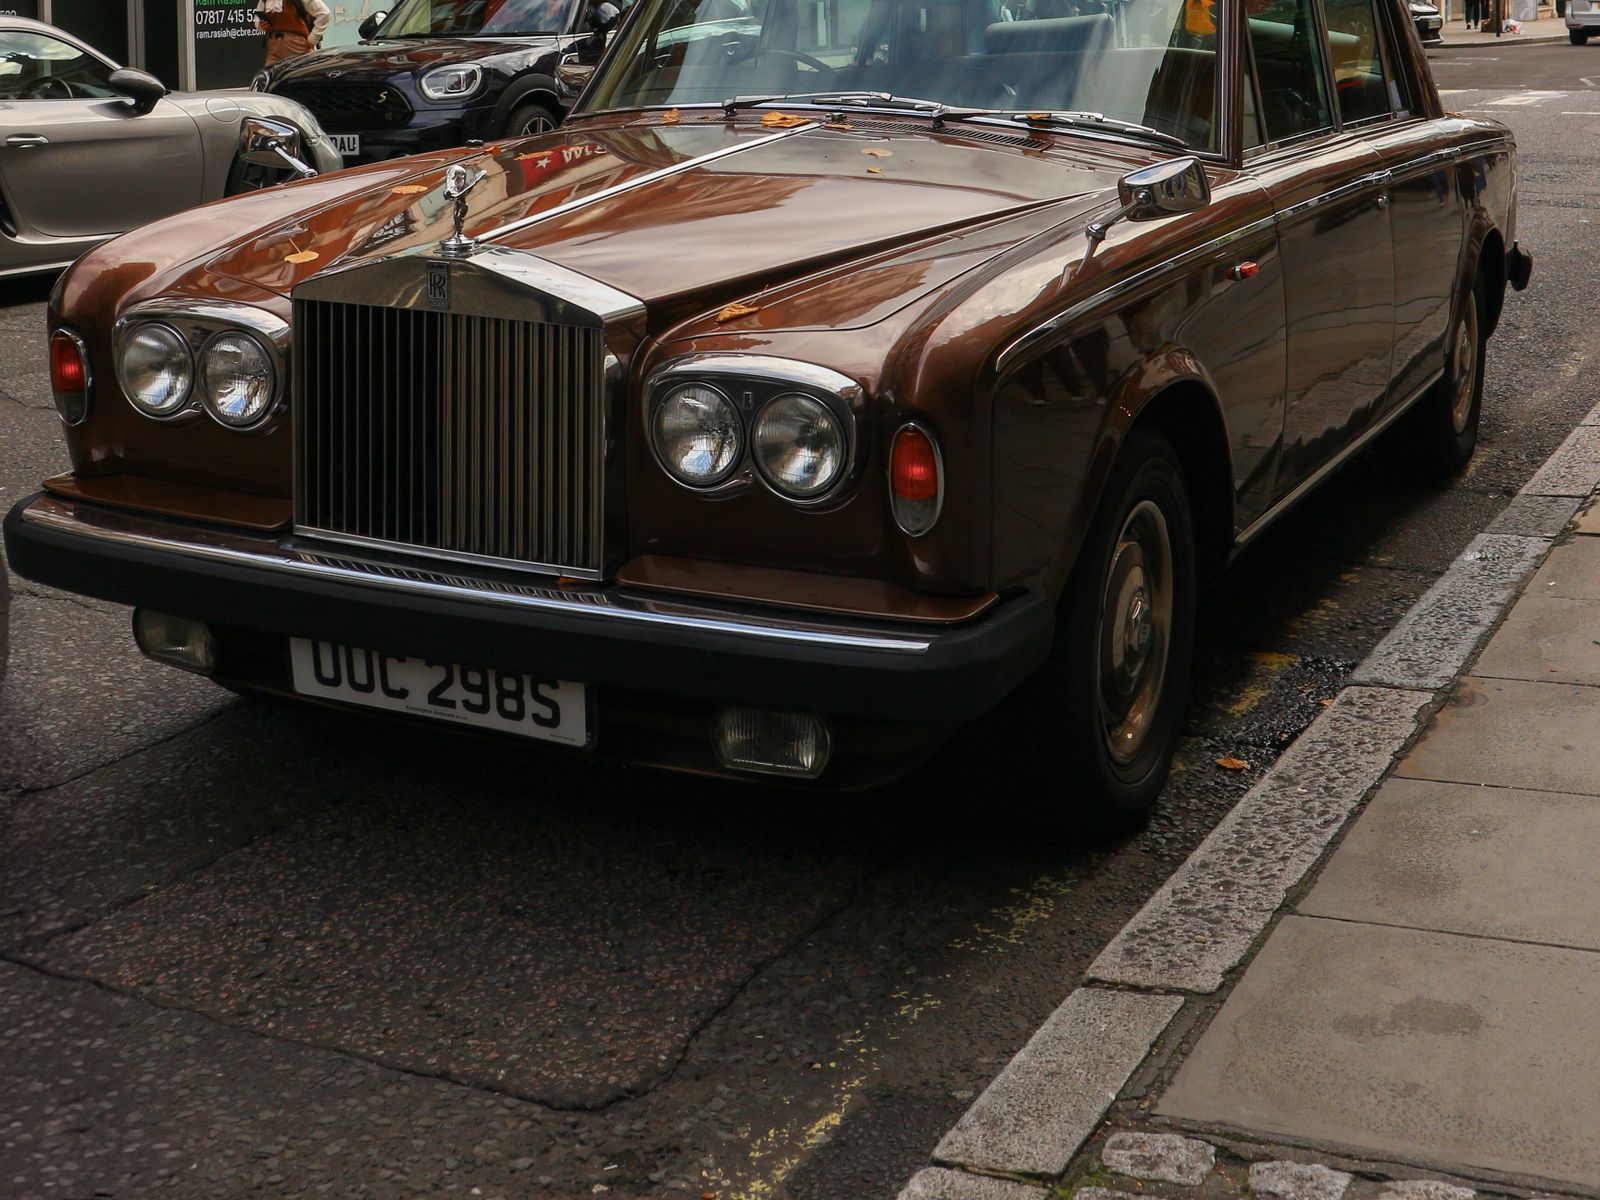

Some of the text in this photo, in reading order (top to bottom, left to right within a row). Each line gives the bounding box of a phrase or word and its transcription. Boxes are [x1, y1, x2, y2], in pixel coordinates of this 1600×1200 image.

[195, 10, 225, 25] 07817
[227, 9, 244, 24] 415
[424, 657, 561, 729] 298S
